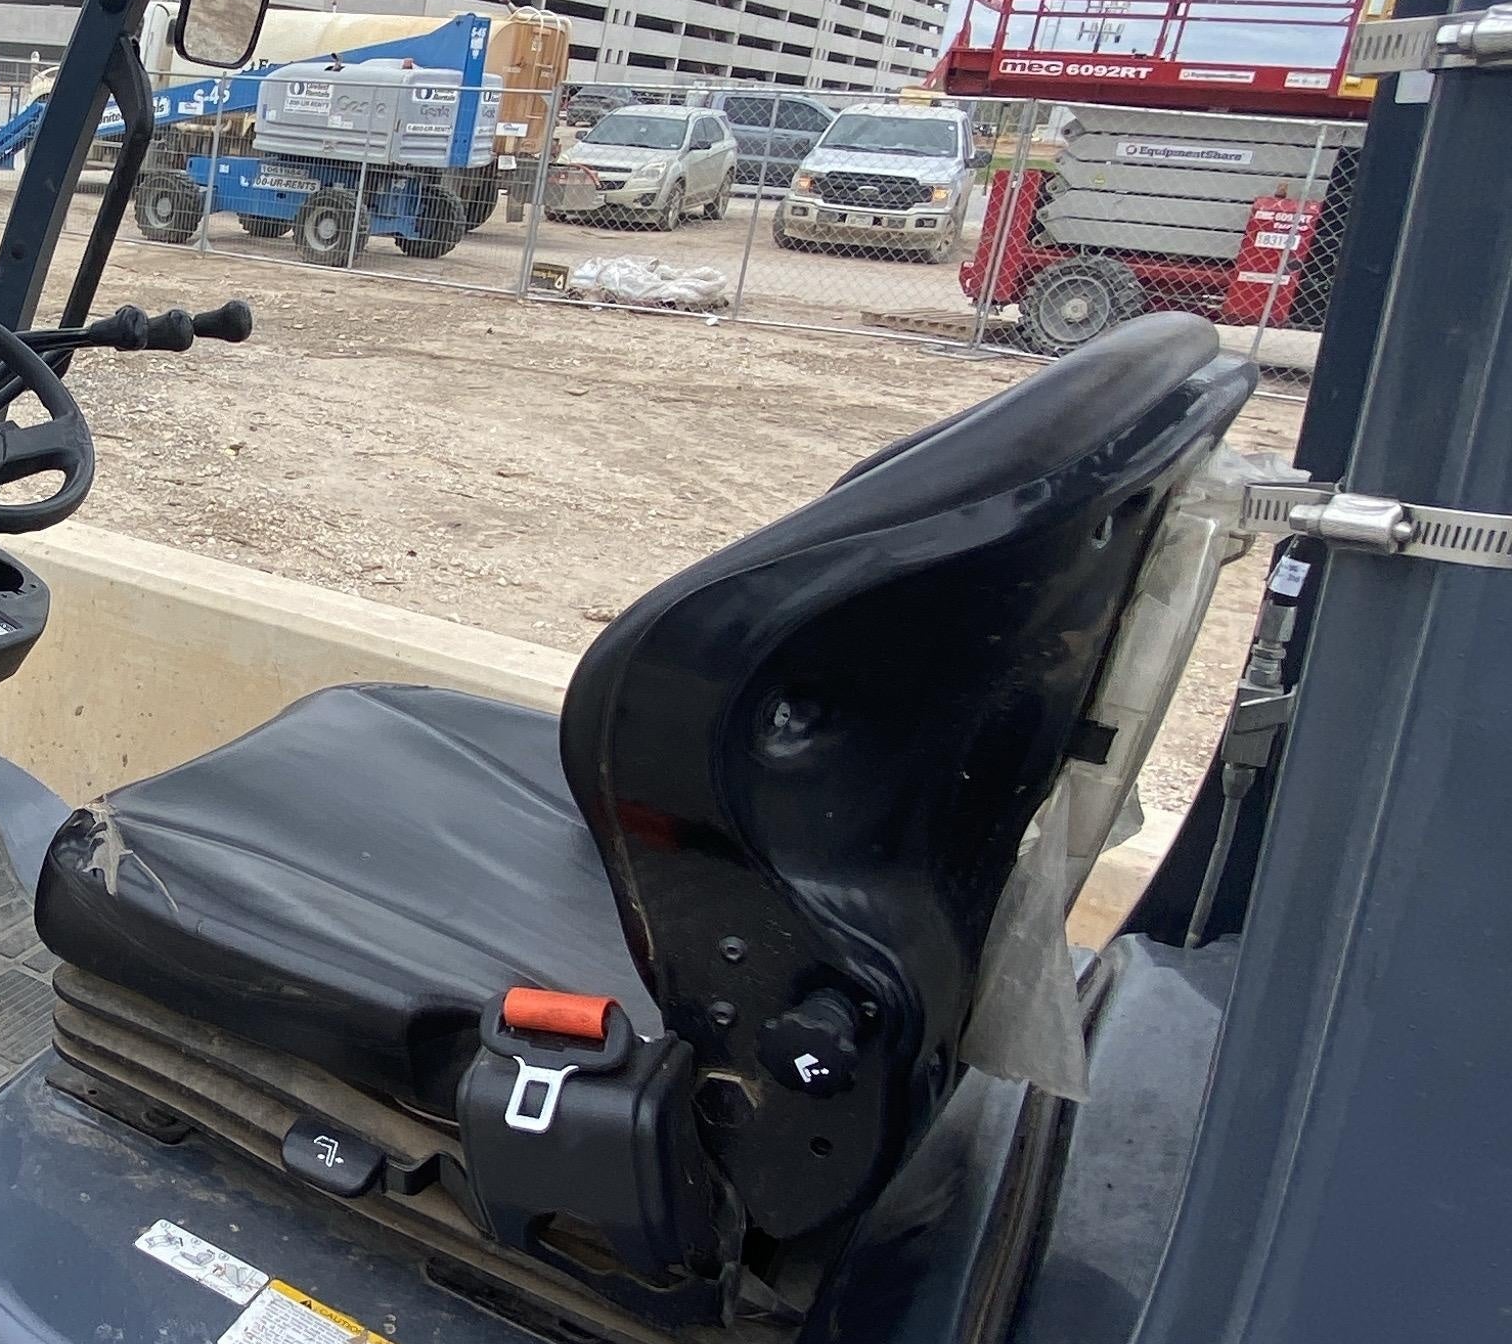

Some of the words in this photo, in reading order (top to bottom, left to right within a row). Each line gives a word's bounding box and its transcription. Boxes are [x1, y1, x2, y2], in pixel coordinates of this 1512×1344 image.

[1001, 61, 1062, 74] mec
[1065, 63, 1153, 79] 6092RT
[1139, 146, 1243, 161] EquipmentShare
